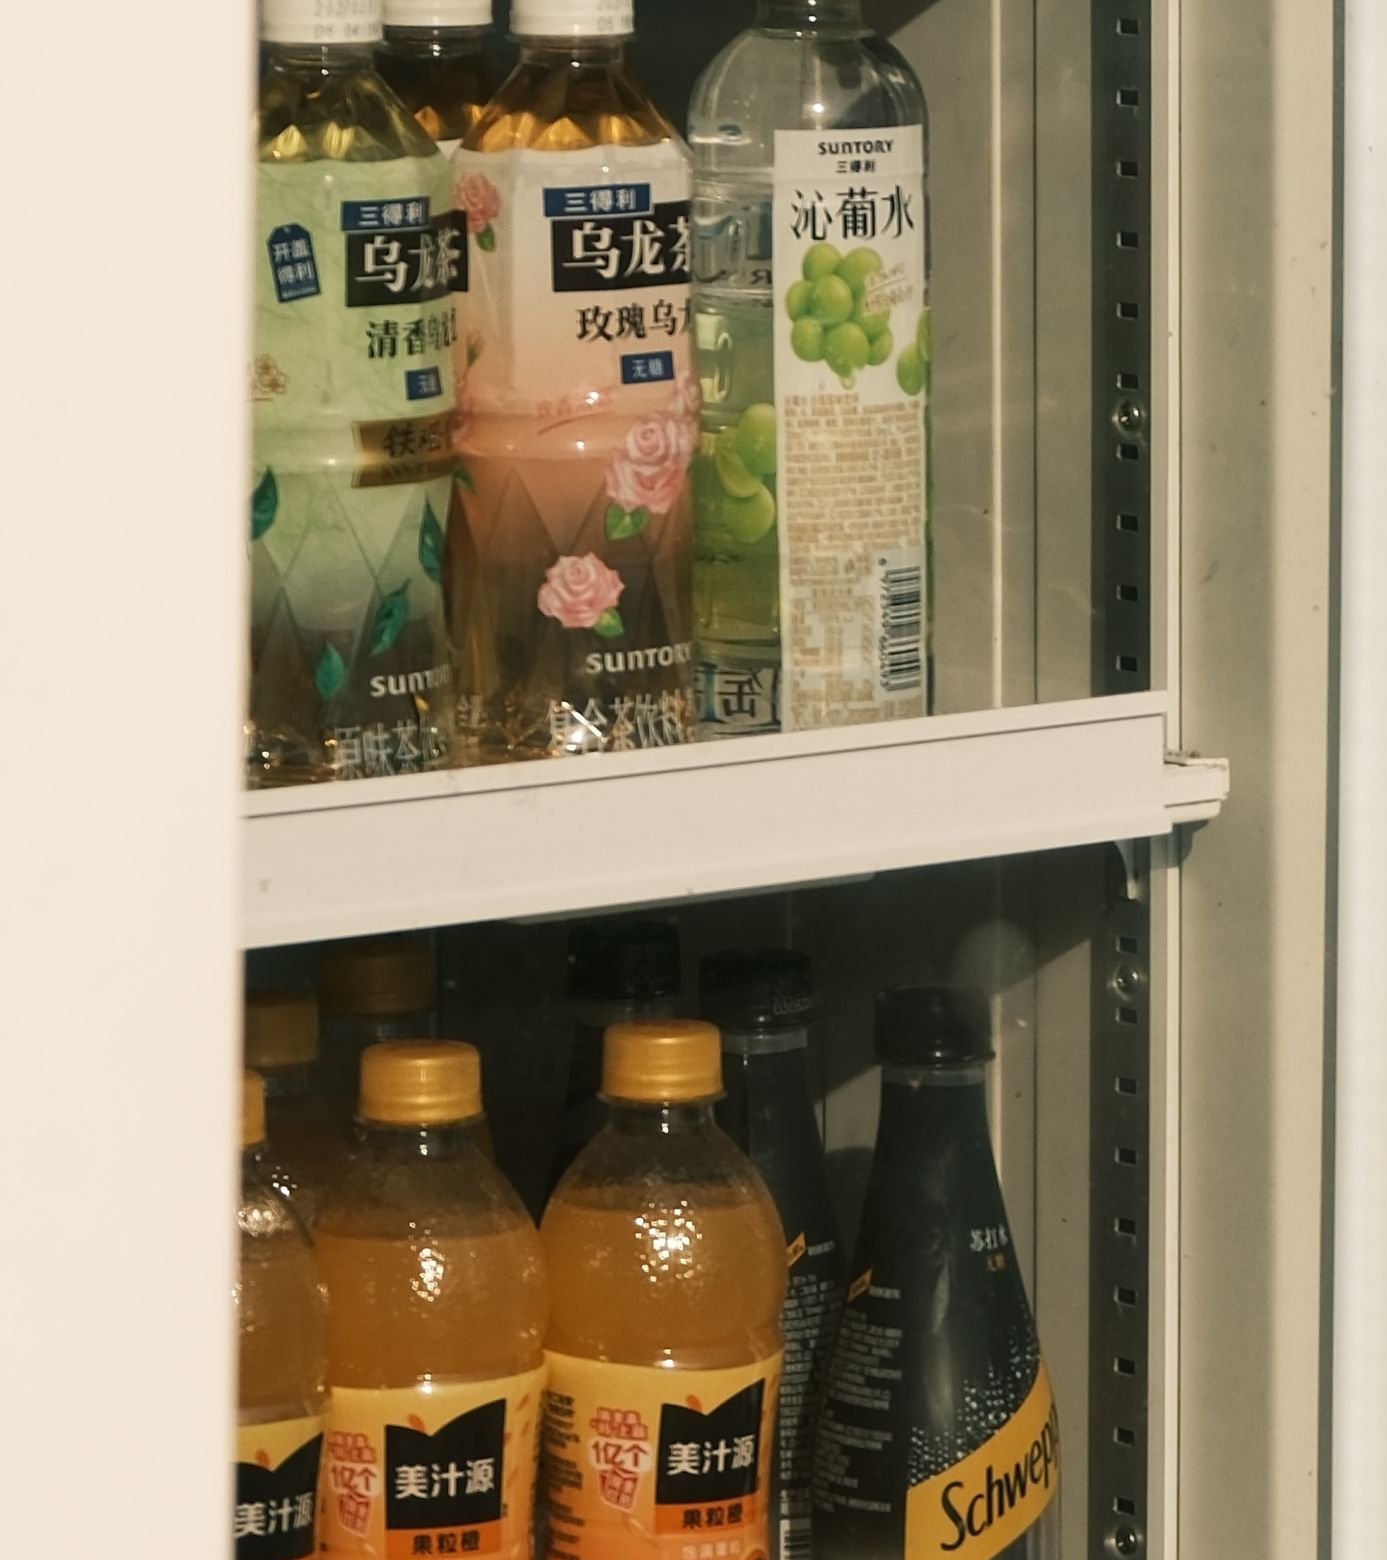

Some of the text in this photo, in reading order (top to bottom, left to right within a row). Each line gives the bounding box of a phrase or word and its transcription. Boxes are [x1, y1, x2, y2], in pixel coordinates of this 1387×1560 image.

[817, 139, 895, 157] SUNTORY
[836, 159, 877, 174] 三得利
[564, 187, 637, 214] 三得利
[789, 185, 916, 240] 沁葡水
[358, 203, 428, 226] 三得利
[628, 356, 665, 379] 无糖
[666, 1432, 756, 1477] 美汁源
[394, 1457, 496, 1500] 美汁源
[940, 1402, 1060, 1553] Schwepp
[680, 1504, 743, 1530] 果粒橙
[412, 1530, 481, 1556] 果粒橙
